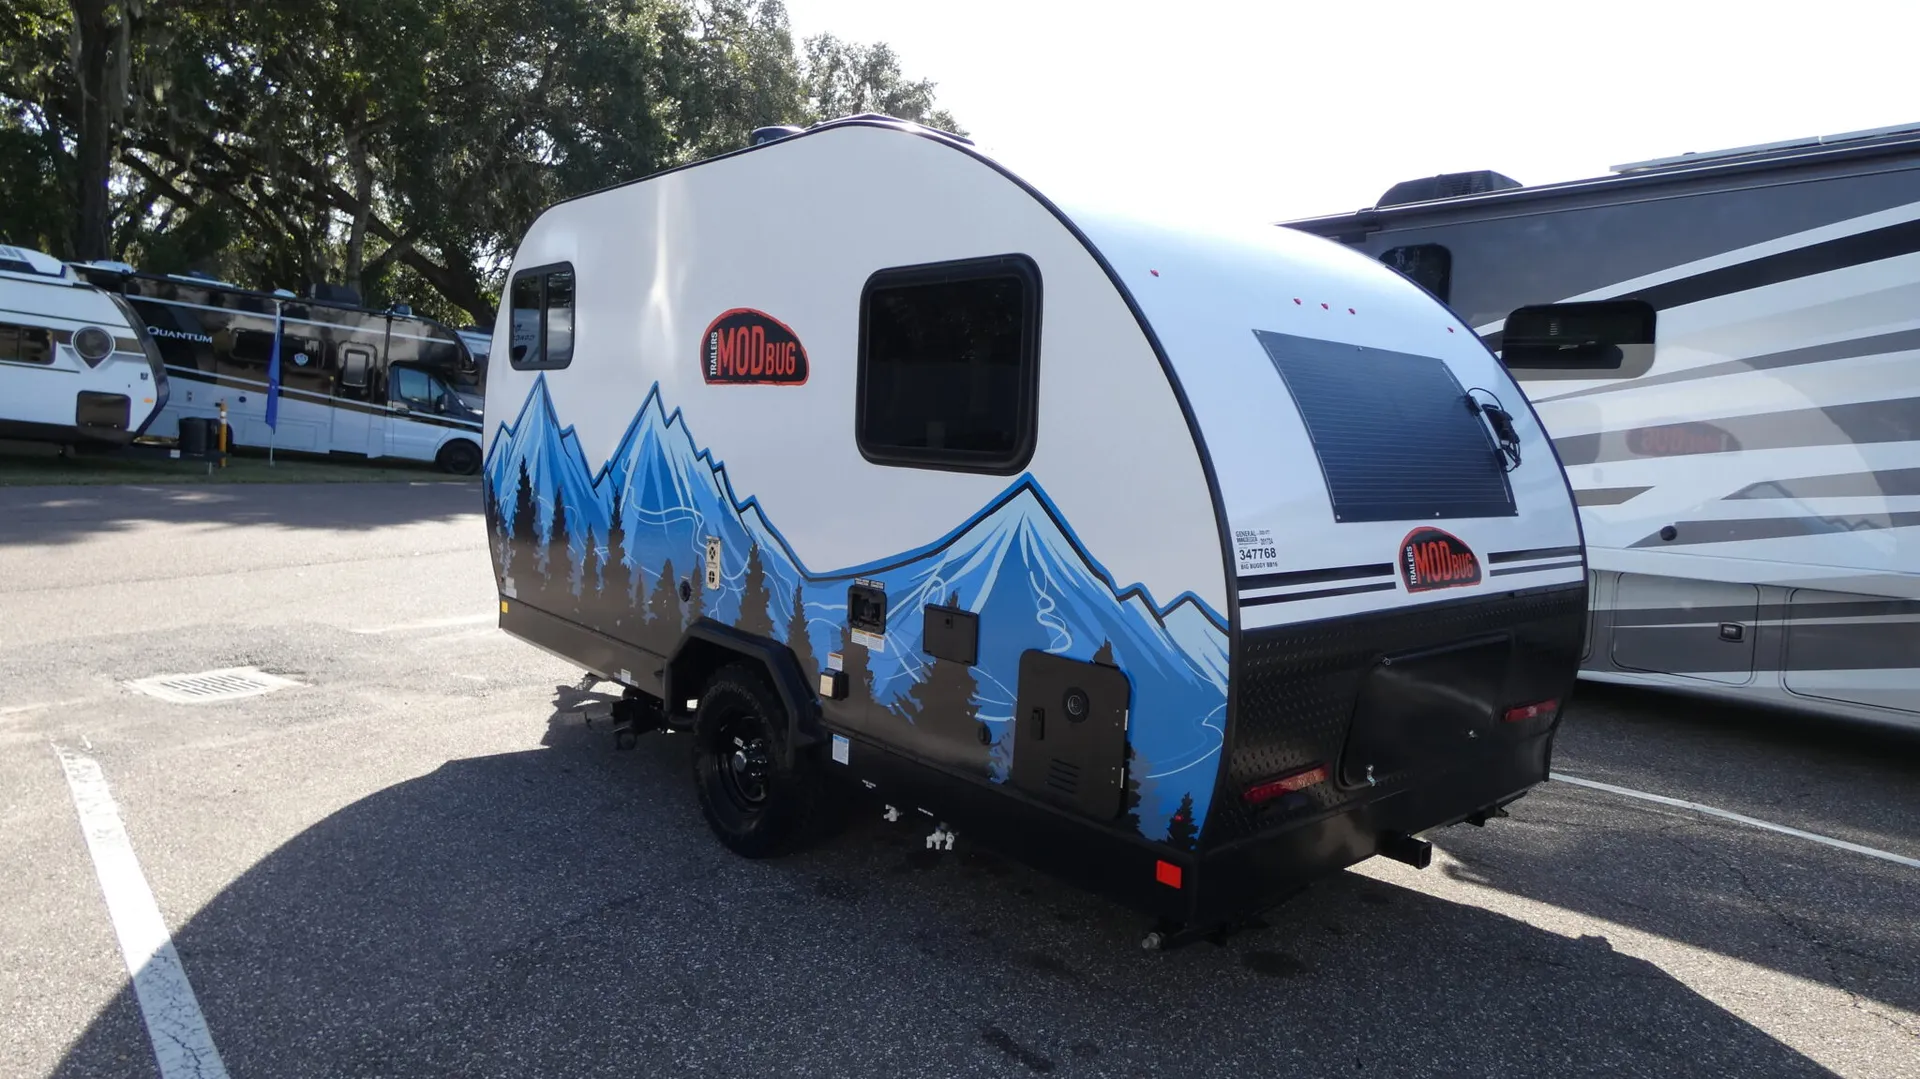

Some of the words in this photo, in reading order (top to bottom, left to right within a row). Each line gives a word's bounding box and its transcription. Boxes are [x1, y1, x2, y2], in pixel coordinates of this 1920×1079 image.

[147, 326, 213, 343] QUANTUM
[710, 332, 718, 376] TRAILERS
[1239, 547, 1277, 560] 347768
[1406, 546, 1417, 585] TRAILERS
